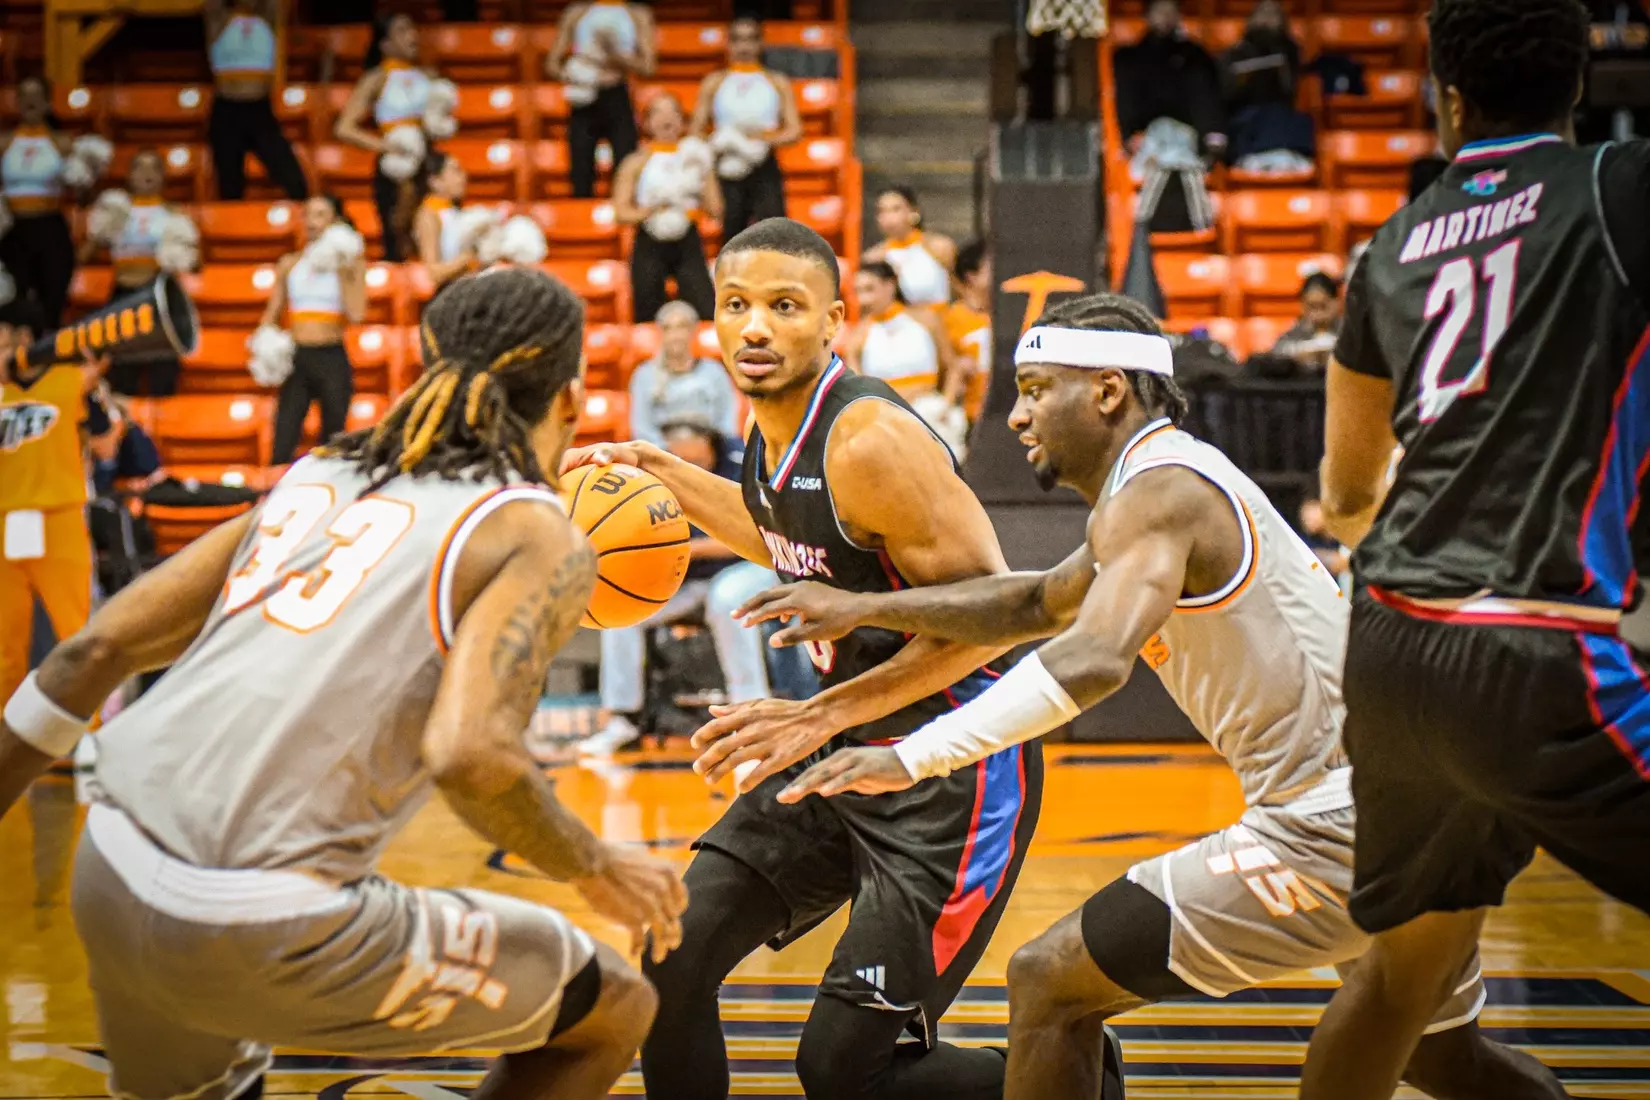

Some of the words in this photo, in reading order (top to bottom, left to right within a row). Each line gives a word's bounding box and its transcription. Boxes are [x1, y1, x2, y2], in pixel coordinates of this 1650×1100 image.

[1399, 182, 1544, 264] MARTINEZ
[1417, 237, 1522, 425] 21
[222, 482, 416, 635] 33
[646, 499, 685, 526] NCA
